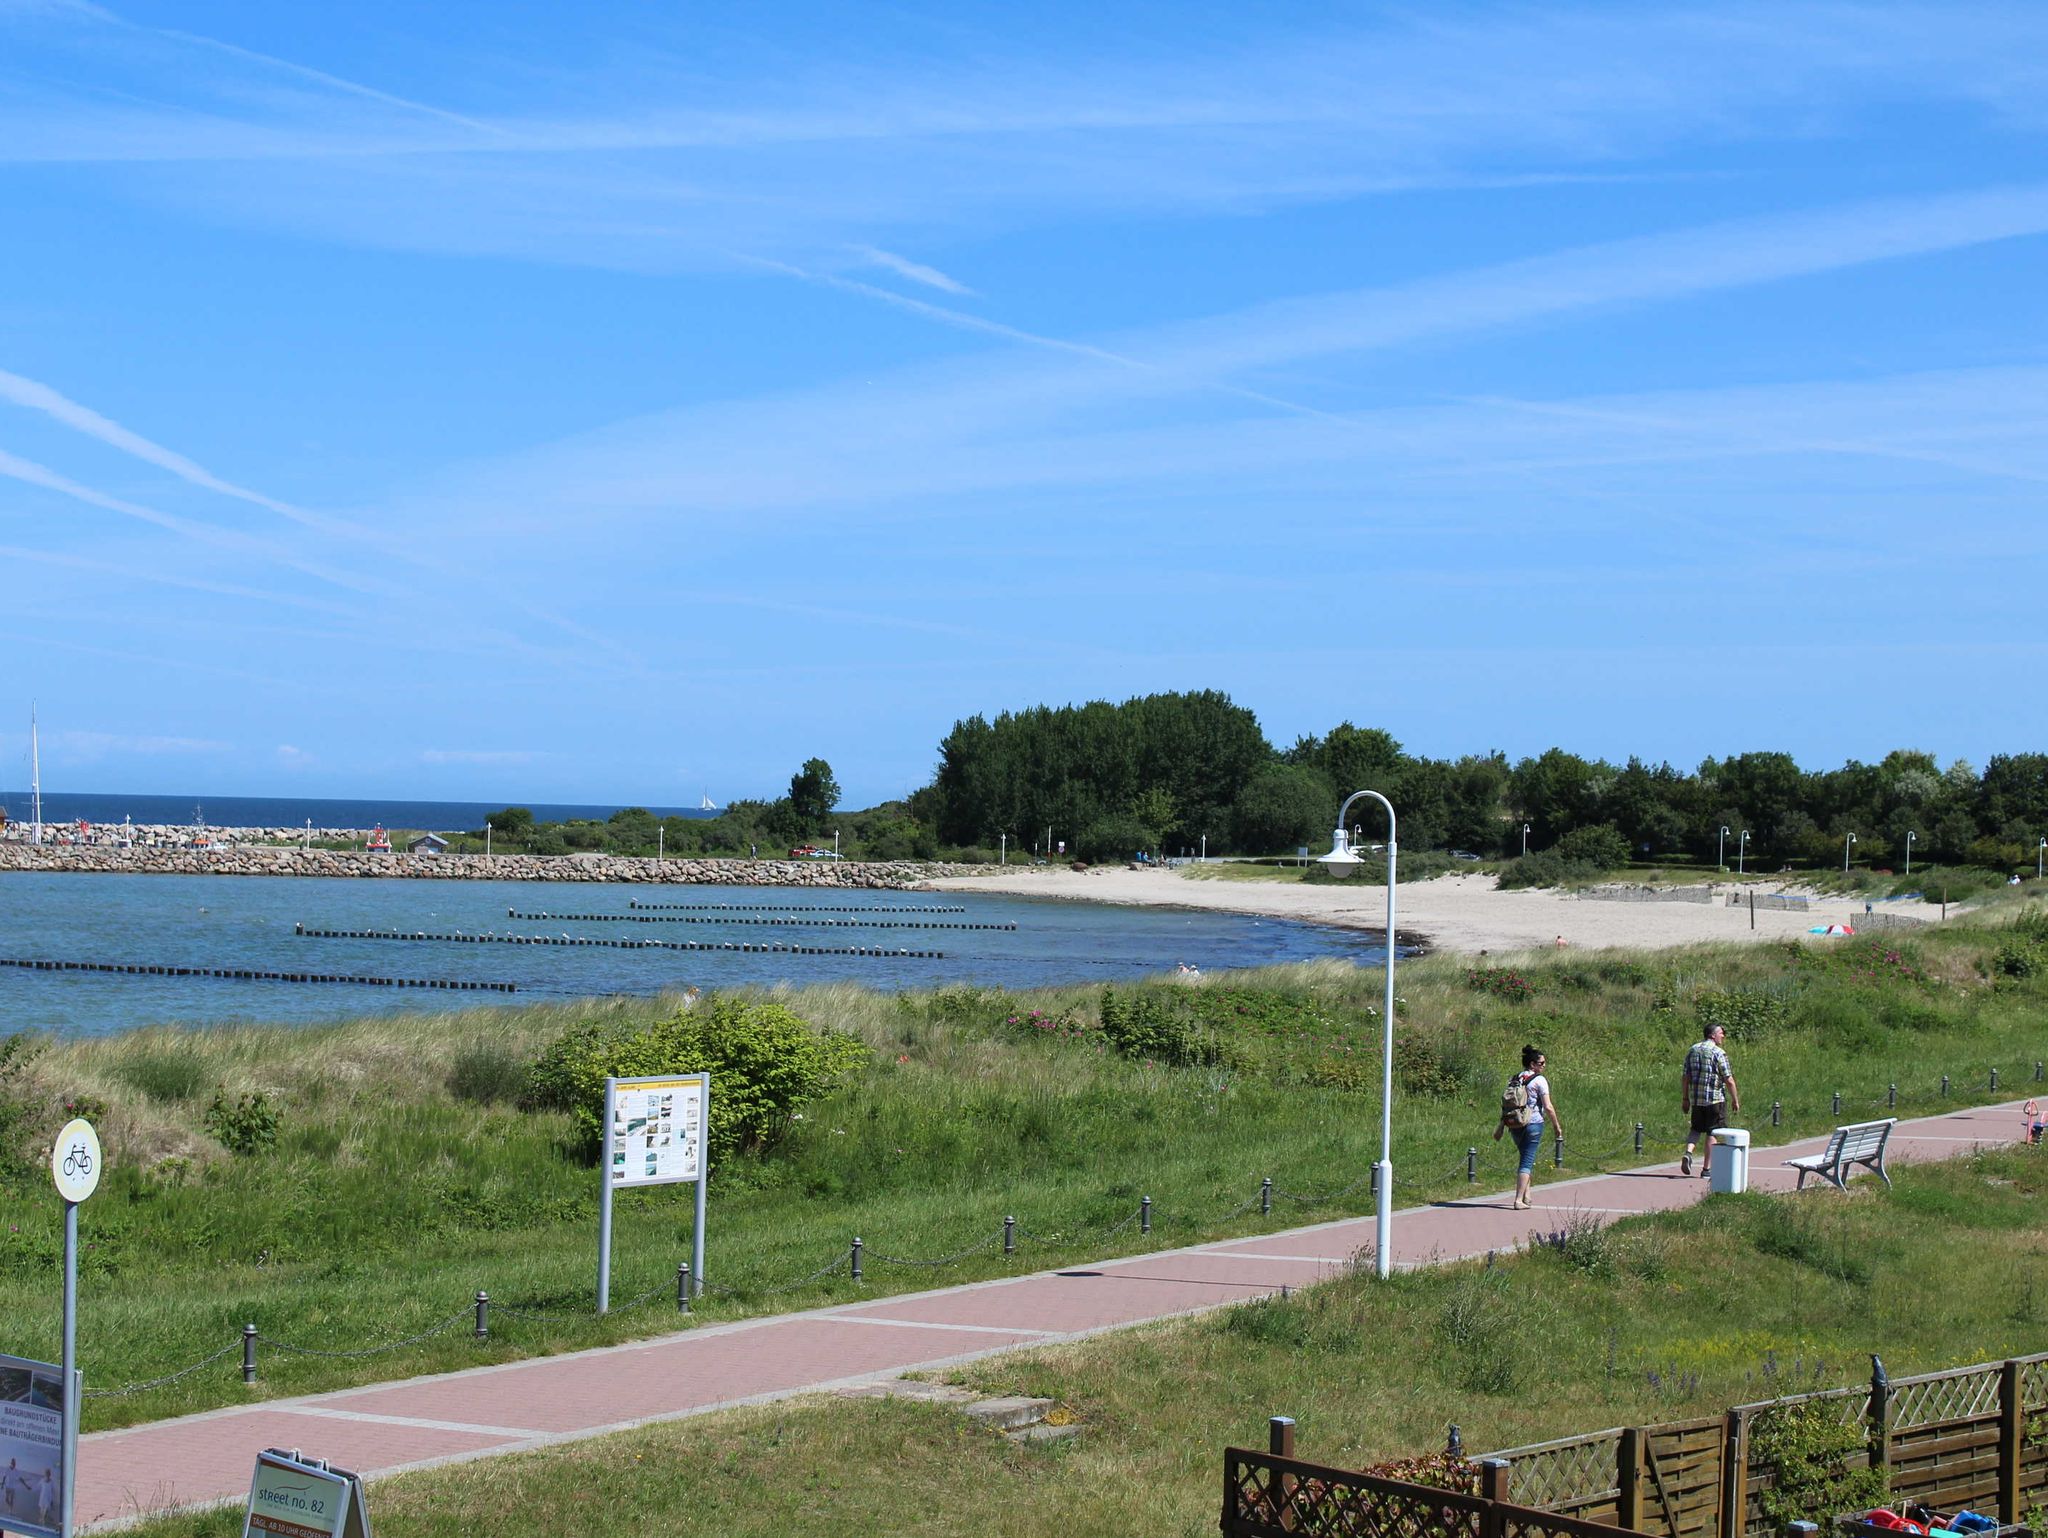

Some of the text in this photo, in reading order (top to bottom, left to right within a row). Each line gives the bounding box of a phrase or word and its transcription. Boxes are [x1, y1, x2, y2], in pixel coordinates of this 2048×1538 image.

[4, 1407, 57, 1424] BAUGRUNDSTÜCKE
[0, 1427, 8, 1436] NE
[291, 1496, 308, 1511] no.
[310, 1499, 325, 1514] 82
[268, 1521, 278, 1531] AB
[278, 1523, 286, 1533] 10
[286, 1525, 299, 1537] UHR
[299, 1528, 330, 1538] GEÖFFN
